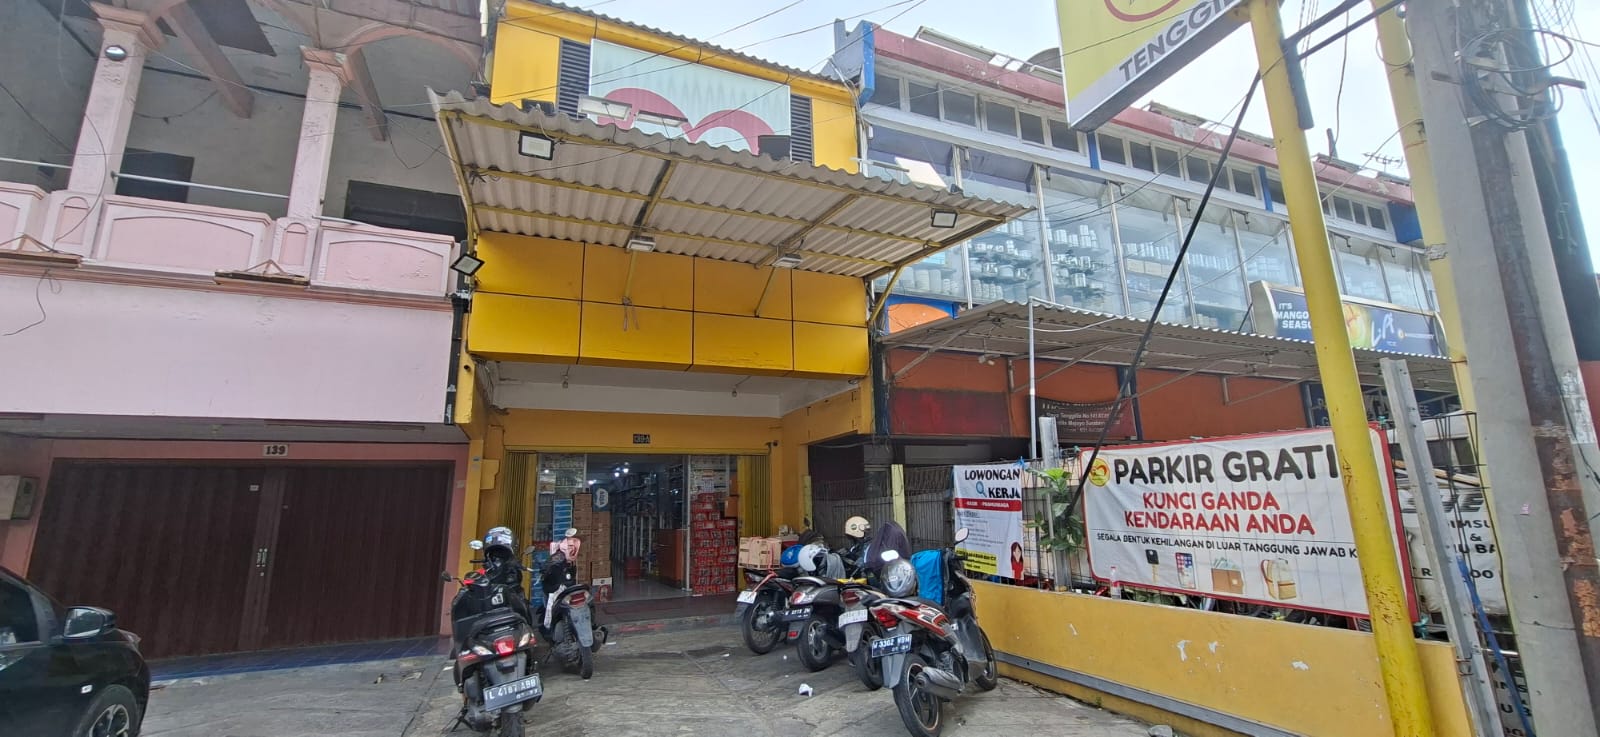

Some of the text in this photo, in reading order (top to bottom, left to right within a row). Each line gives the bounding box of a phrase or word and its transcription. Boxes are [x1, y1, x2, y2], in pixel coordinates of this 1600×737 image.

[1278, 302, 1292, 310] IT'S
[1276, 311, 1309, 320] MANGO
[266, 445, 286, 455] 139
[1114, 444, 1339, 485] PARKIR GRATI
[964, 468, 1020, 481] LOWONGAN
[988, 487, 1021, 499] KERJA
[1142, 491, 1280, 511] KUNCI GANDA
[1124, 511, 1316, 536] KENDARAAN ANDA
[1096, 532, 1121, 543] SEGALA
[1123, 534, 1151, 545] BENTUK
[1151, 537, 1204, 549] KEHILANGAN
[1205, 540, 1215, 549] DI
[1216, 541, 1241, 551] LUAR
[1243, 542, 1300, 555] TANGGUNG
[1303, 545, 1346, 557] JAWAB
[489, 691, 495, 699] L
